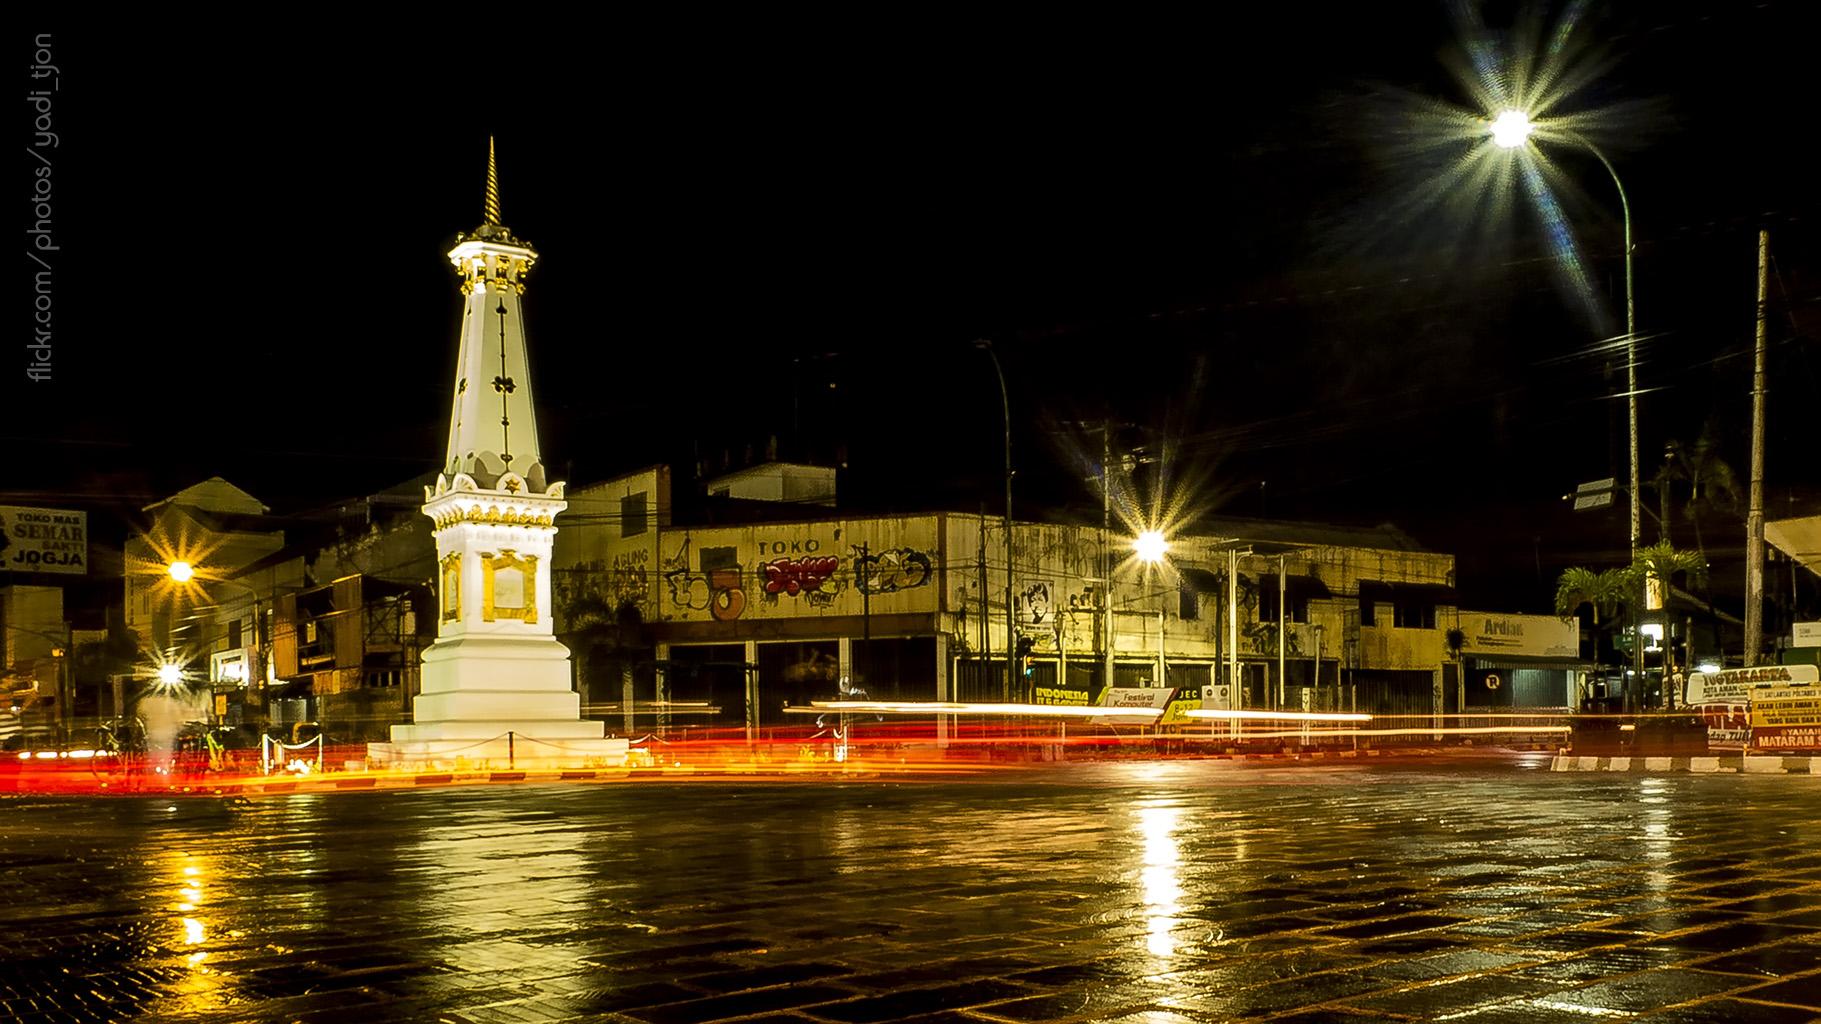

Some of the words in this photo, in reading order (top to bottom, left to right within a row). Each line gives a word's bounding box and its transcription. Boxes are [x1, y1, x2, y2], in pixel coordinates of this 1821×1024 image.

[16, 513, 51, 523] TOKO
[54, 515, 80, 524] MAS
[13, 523, 83, 541] SEMAR
[42, 541, 84, 551] SAKTI
[758, 539, 820, 556] TOKO
[13, 550, 82, 565] JOGJA
[613, 548, 648, 568] AGUNG
[1036, 687, 1089, 701] INDONESIA
[1123, 692, 1155, 701] Festival
[1758, 736, 1815, 748] MATARAM
